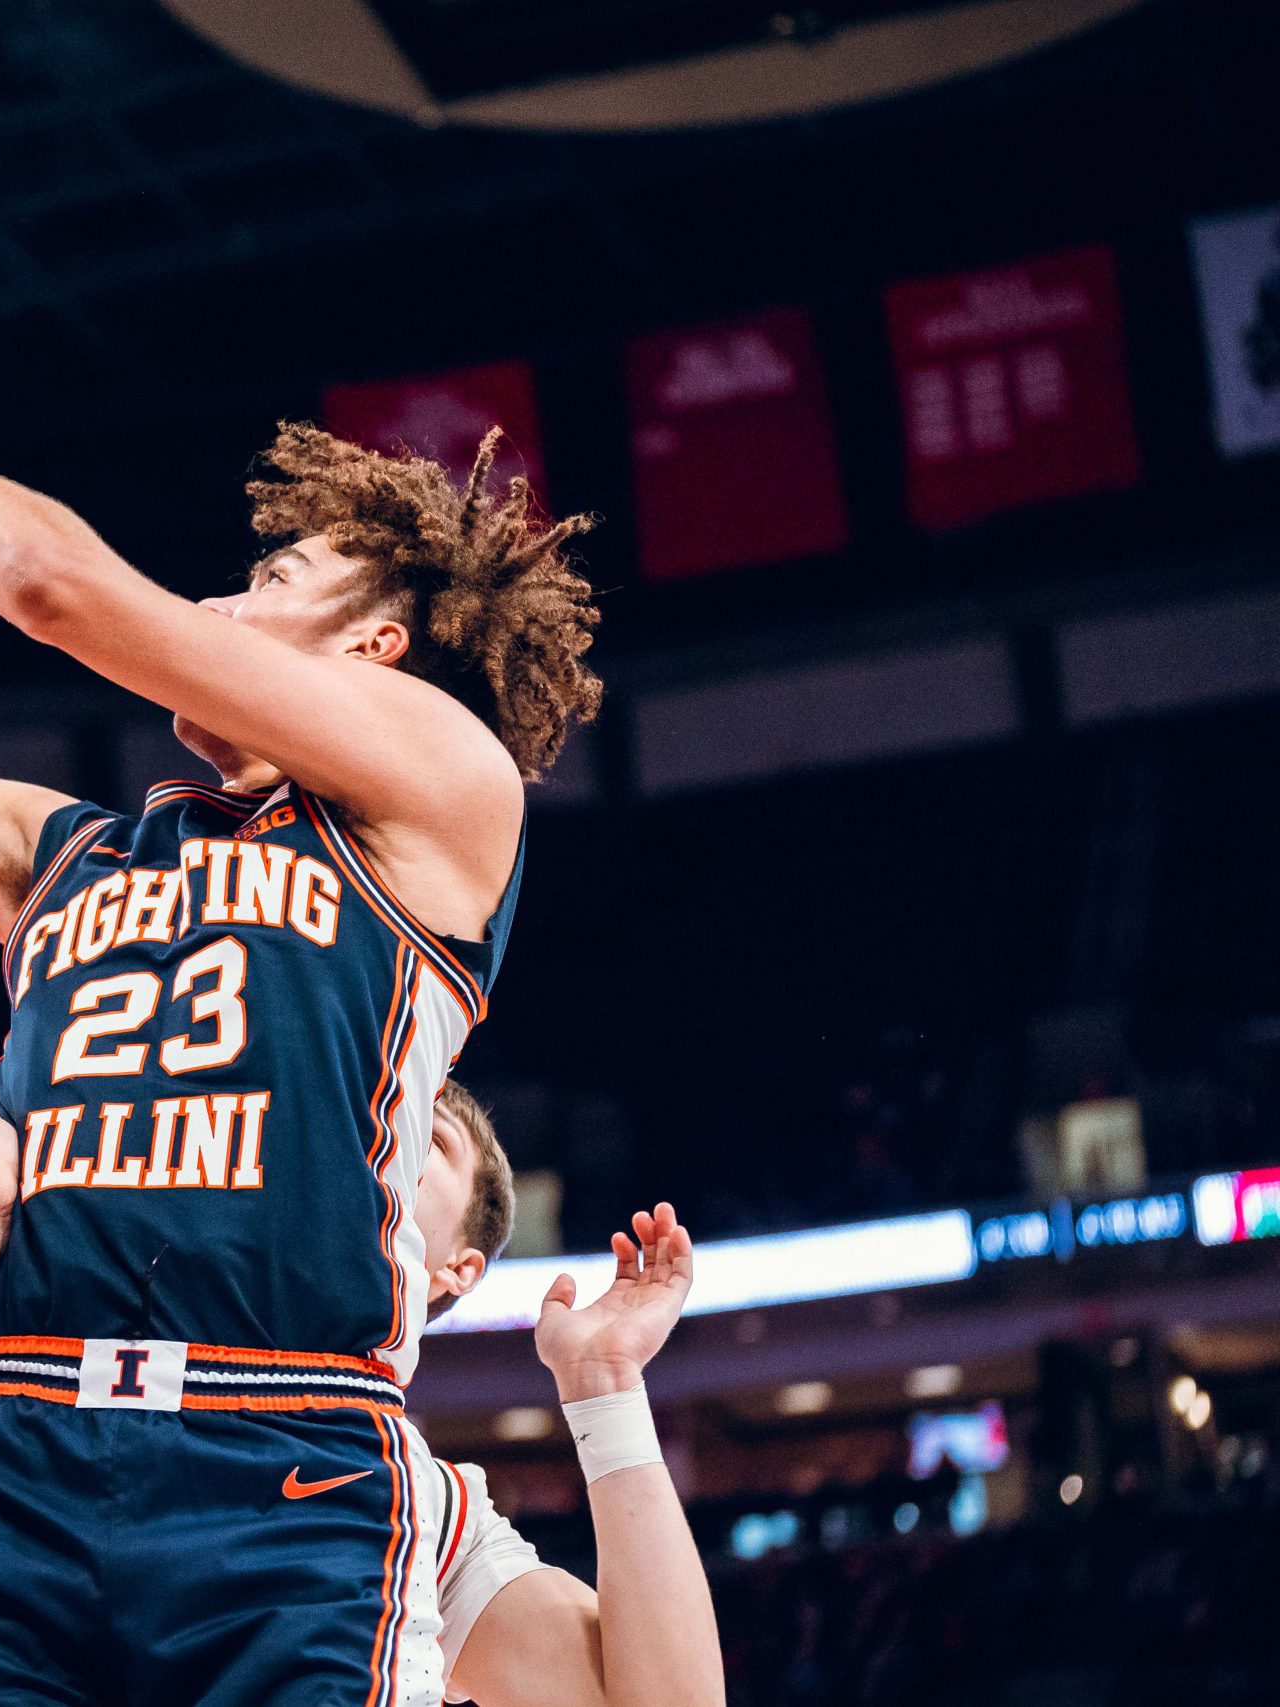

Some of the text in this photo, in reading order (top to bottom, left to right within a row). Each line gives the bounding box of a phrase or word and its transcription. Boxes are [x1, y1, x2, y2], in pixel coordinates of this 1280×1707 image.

[15, 838, 342, 1009] FIGHTING
[51, 935, 247, 1085] 23
[21, 1091, 271, 1203] ILLINI
[111, 1349, 150, 1398] I
